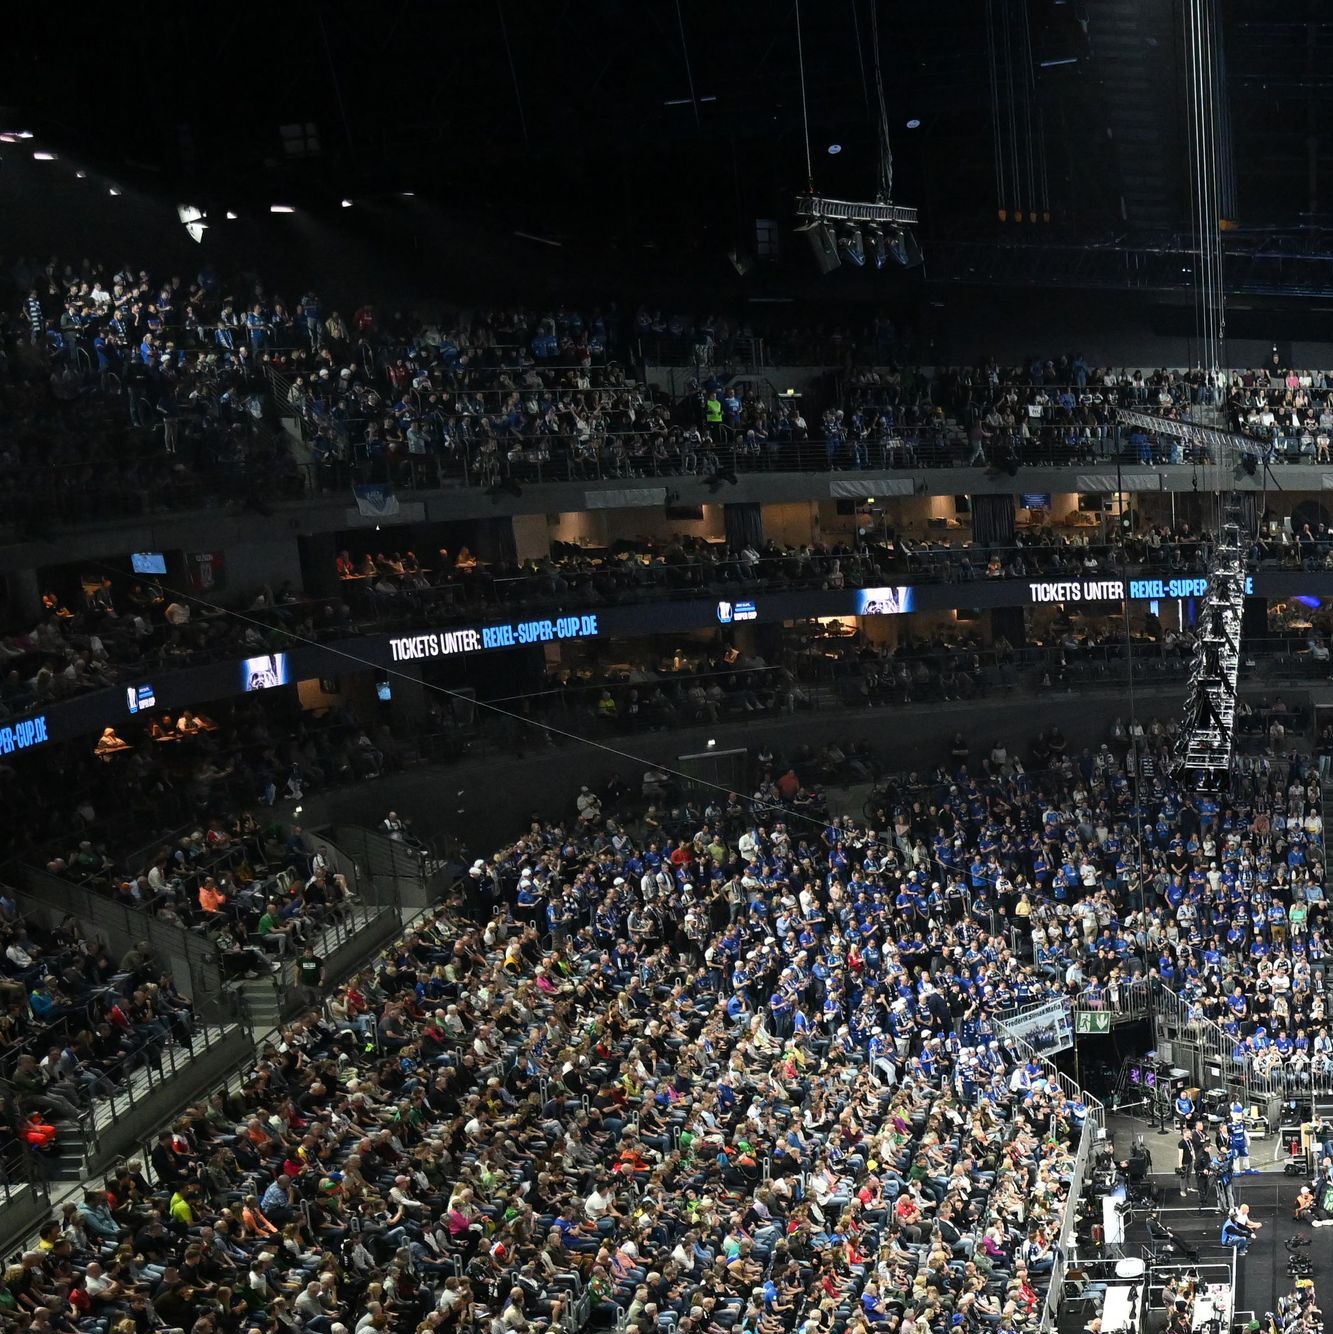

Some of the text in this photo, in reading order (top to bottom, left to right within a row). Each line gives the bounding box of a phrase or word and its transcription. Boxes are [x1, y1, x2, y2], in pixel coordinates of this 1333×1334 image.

[1030, 582, 1081, 602] TICKETS
[390, 615, 598, 661] TICKETS UNTER: REXEL-SUPER-CUP.DE
